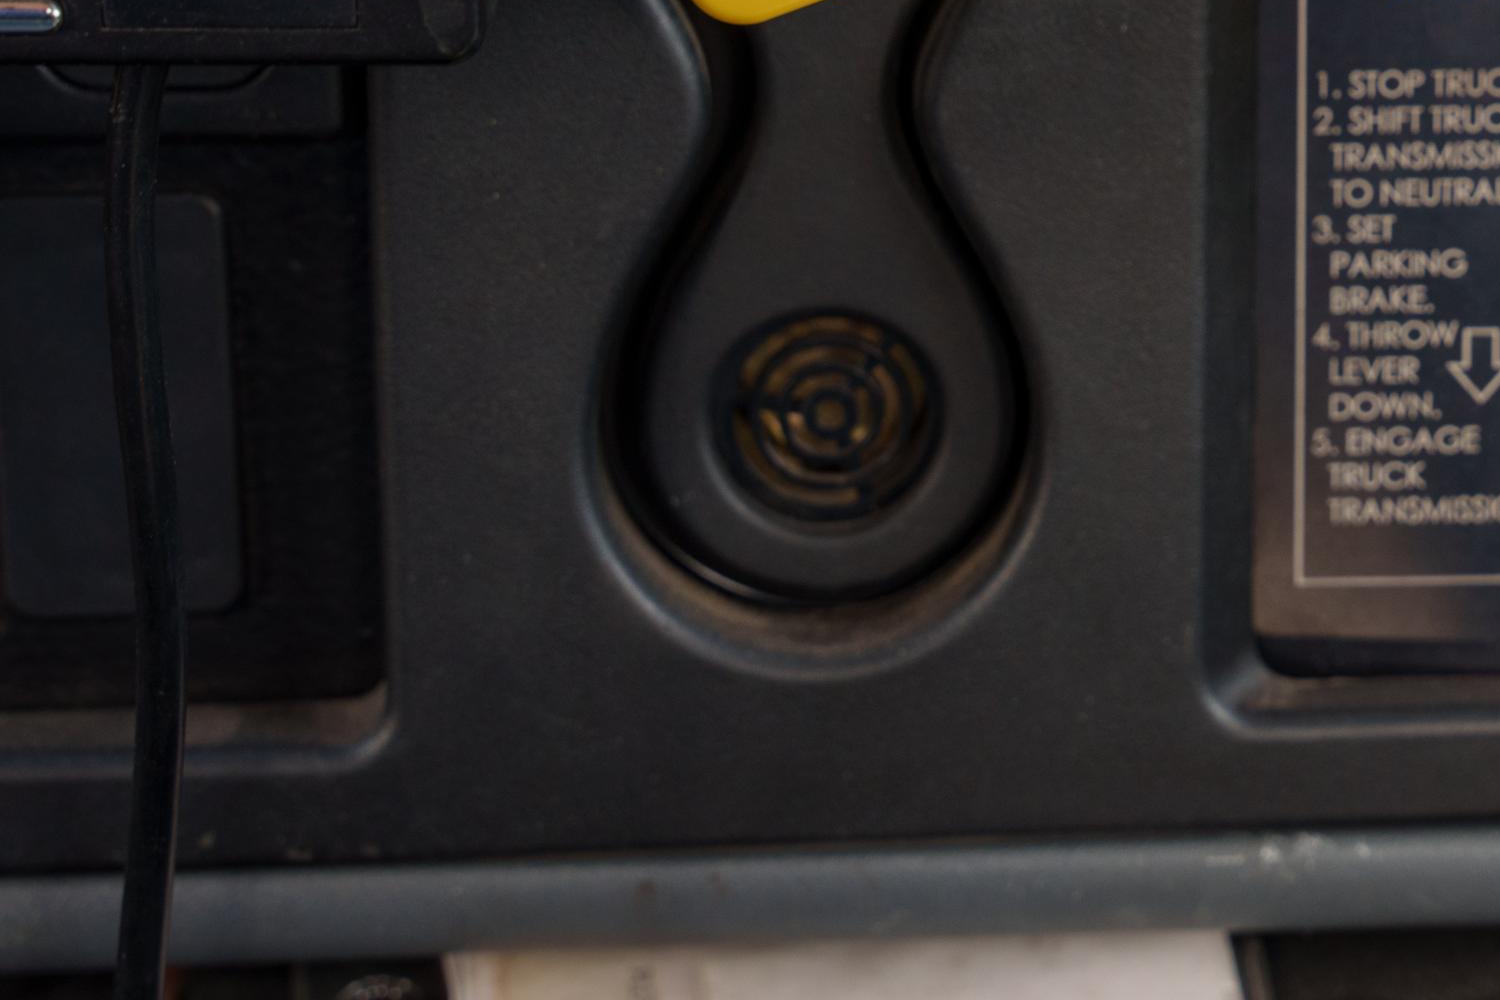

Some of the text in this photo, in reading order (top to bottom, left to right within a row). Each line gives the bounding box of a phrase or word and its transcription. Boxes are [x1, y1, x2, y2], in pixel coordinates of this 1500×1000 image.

[1317, 70, 1342, 99] 1.
[1348, 69, 1426, 99] STOP
[1312, 106, 1341, 136] 2.
[1348, 105, 1424, 135] SHIFT
[1329, 178, 1374, 209] TO
[1312, 214, 1397, 245] 3. SET
[1329, 248, 1469, 280] PARKING
[1329, 284, 1435, 315] BRAKE.
[1312, 320, 1460, 350] 4. THROW
[1328, 355, 1421, 386] LEVER
[1328, 391, 1442, 422] DOWN.
[1345, 424, 1482, 456] ENGAGE
[1326, 460, 1426, 491] TRUCK
